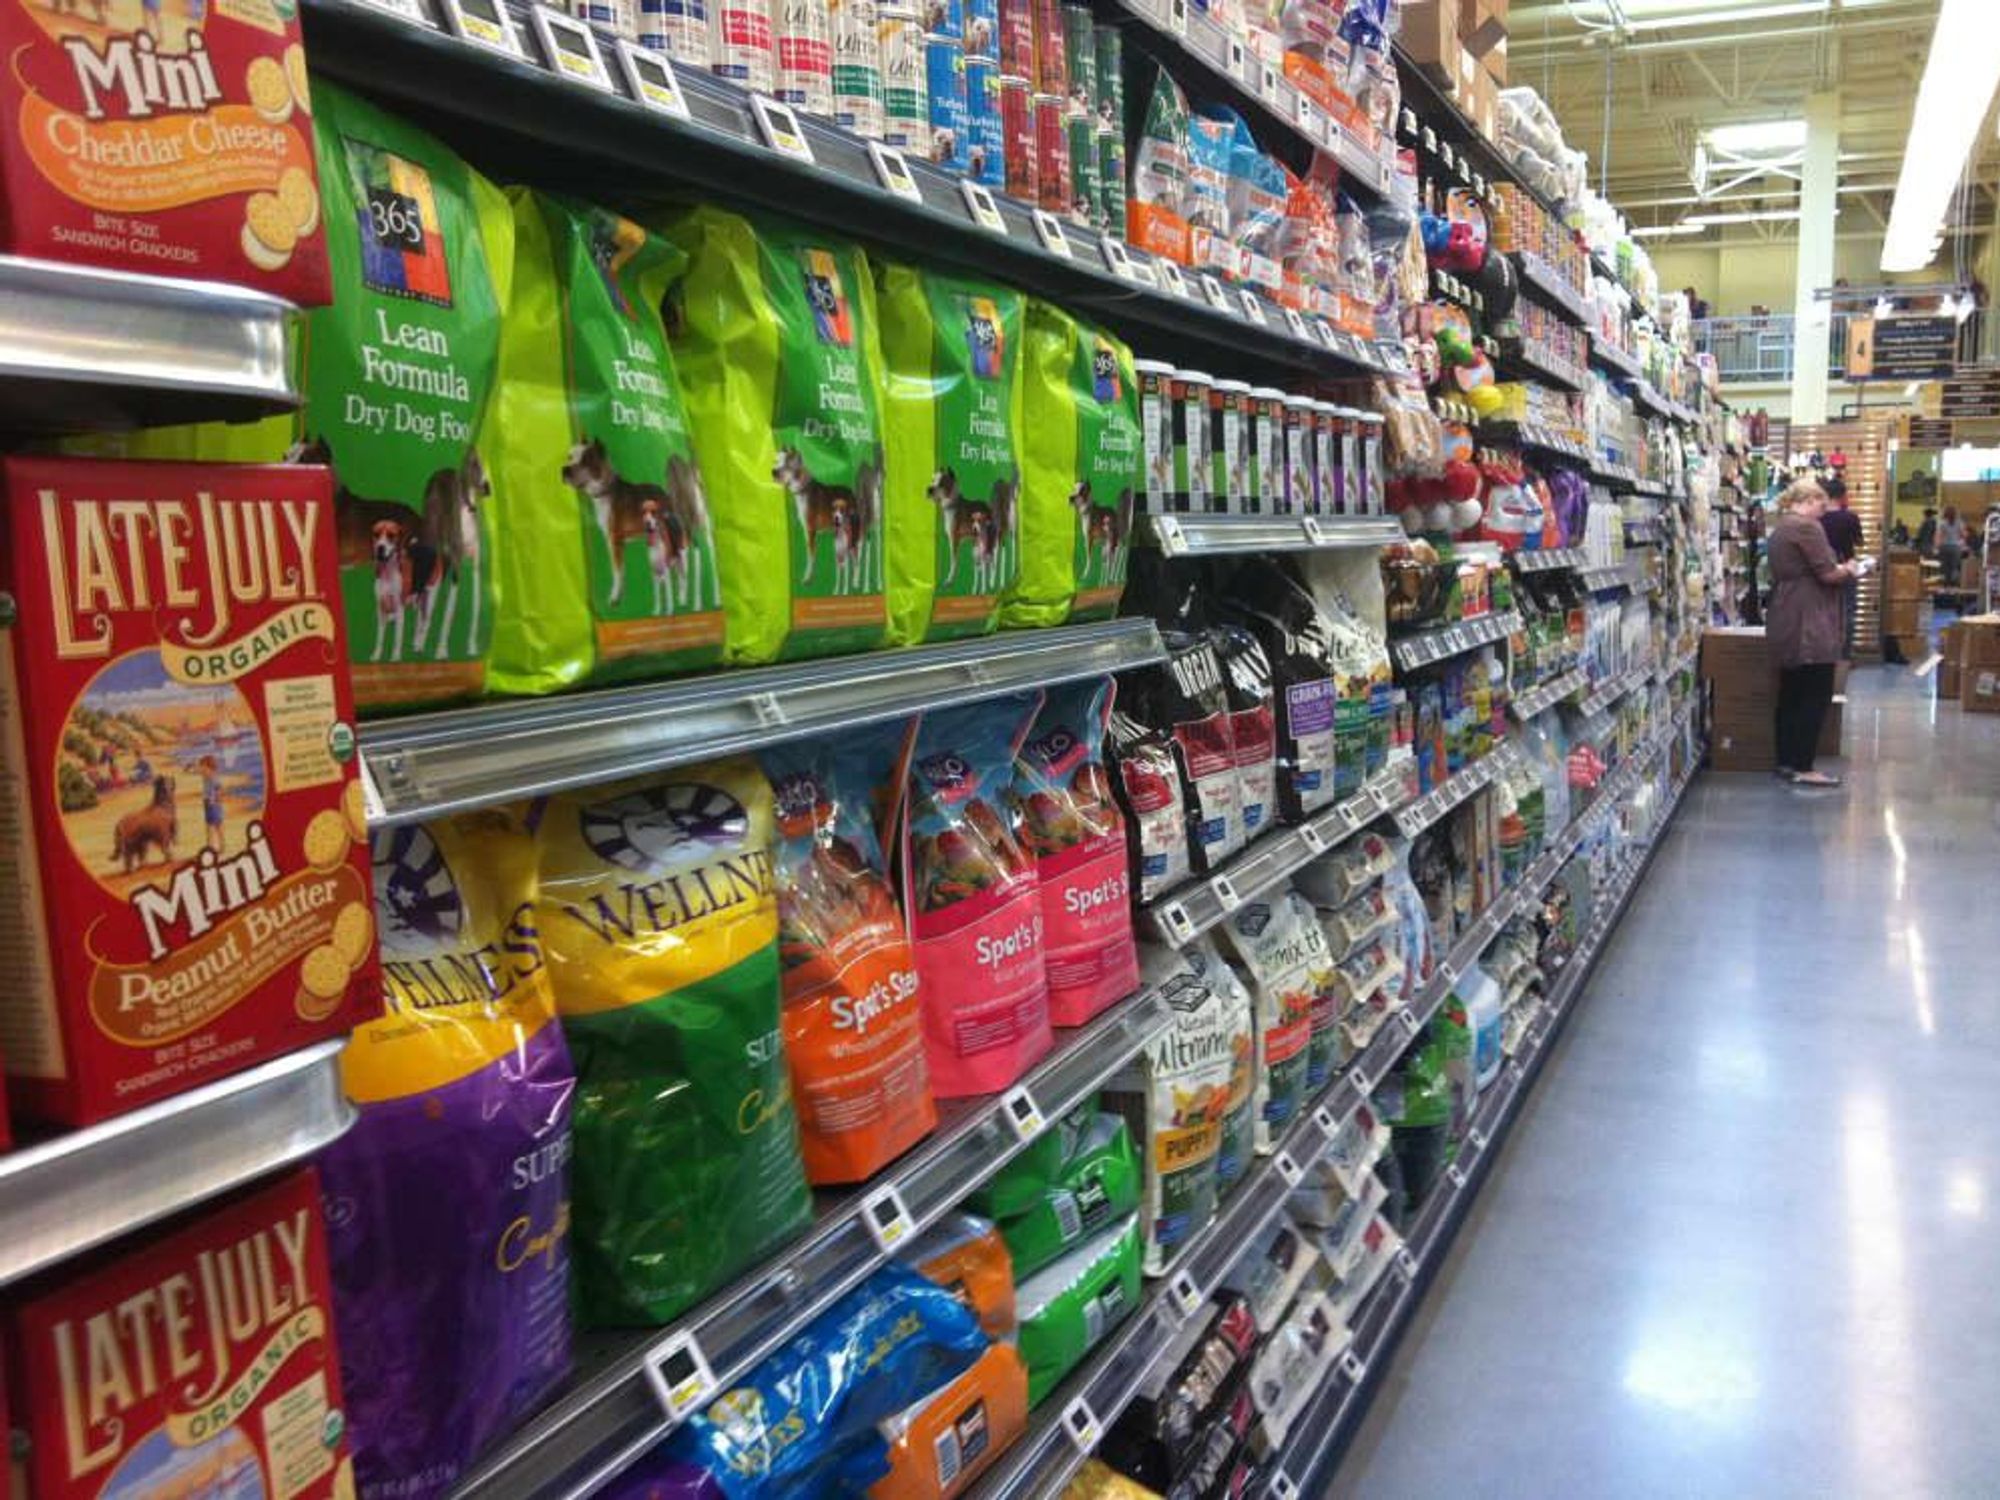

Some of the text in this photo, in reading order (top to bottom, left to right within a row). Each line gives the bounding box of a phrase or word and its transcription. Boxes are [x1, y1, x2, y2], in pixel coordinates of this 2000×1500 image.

[63, 31, 222, 118] Mini
[47, 112, 288, 167] Cheddar Cheese
[51, 225, 127, 250] SANDWICH
[370, 200, 423, 245] 365
[376, 309, 449, 357] Lean
[361, 345, 470, 402] Formula
[344, 394, 389, 434] Dry
[394, 403, 436, 443] Dog
[803, 418, 838, 443] Dry
[38, 489, 321, 659] LATE JULY
[183, 609, 320, 679] ORGANIC
[133, 824, 280, 960] Mini
[1064, 877, 1120, 916] Spot's
[117, 931, 243, 1013] Peanut
[242, 880, 339, 946] Butter
[974, 924, 1033, 969] Spot's
[830, 980, 892, 1034] Spot's
[52, 1270, 203, 1482] LATE
[183, 1207, 311, 1407] JULY
[188, 1315, 311, 1441] ORGANIC
